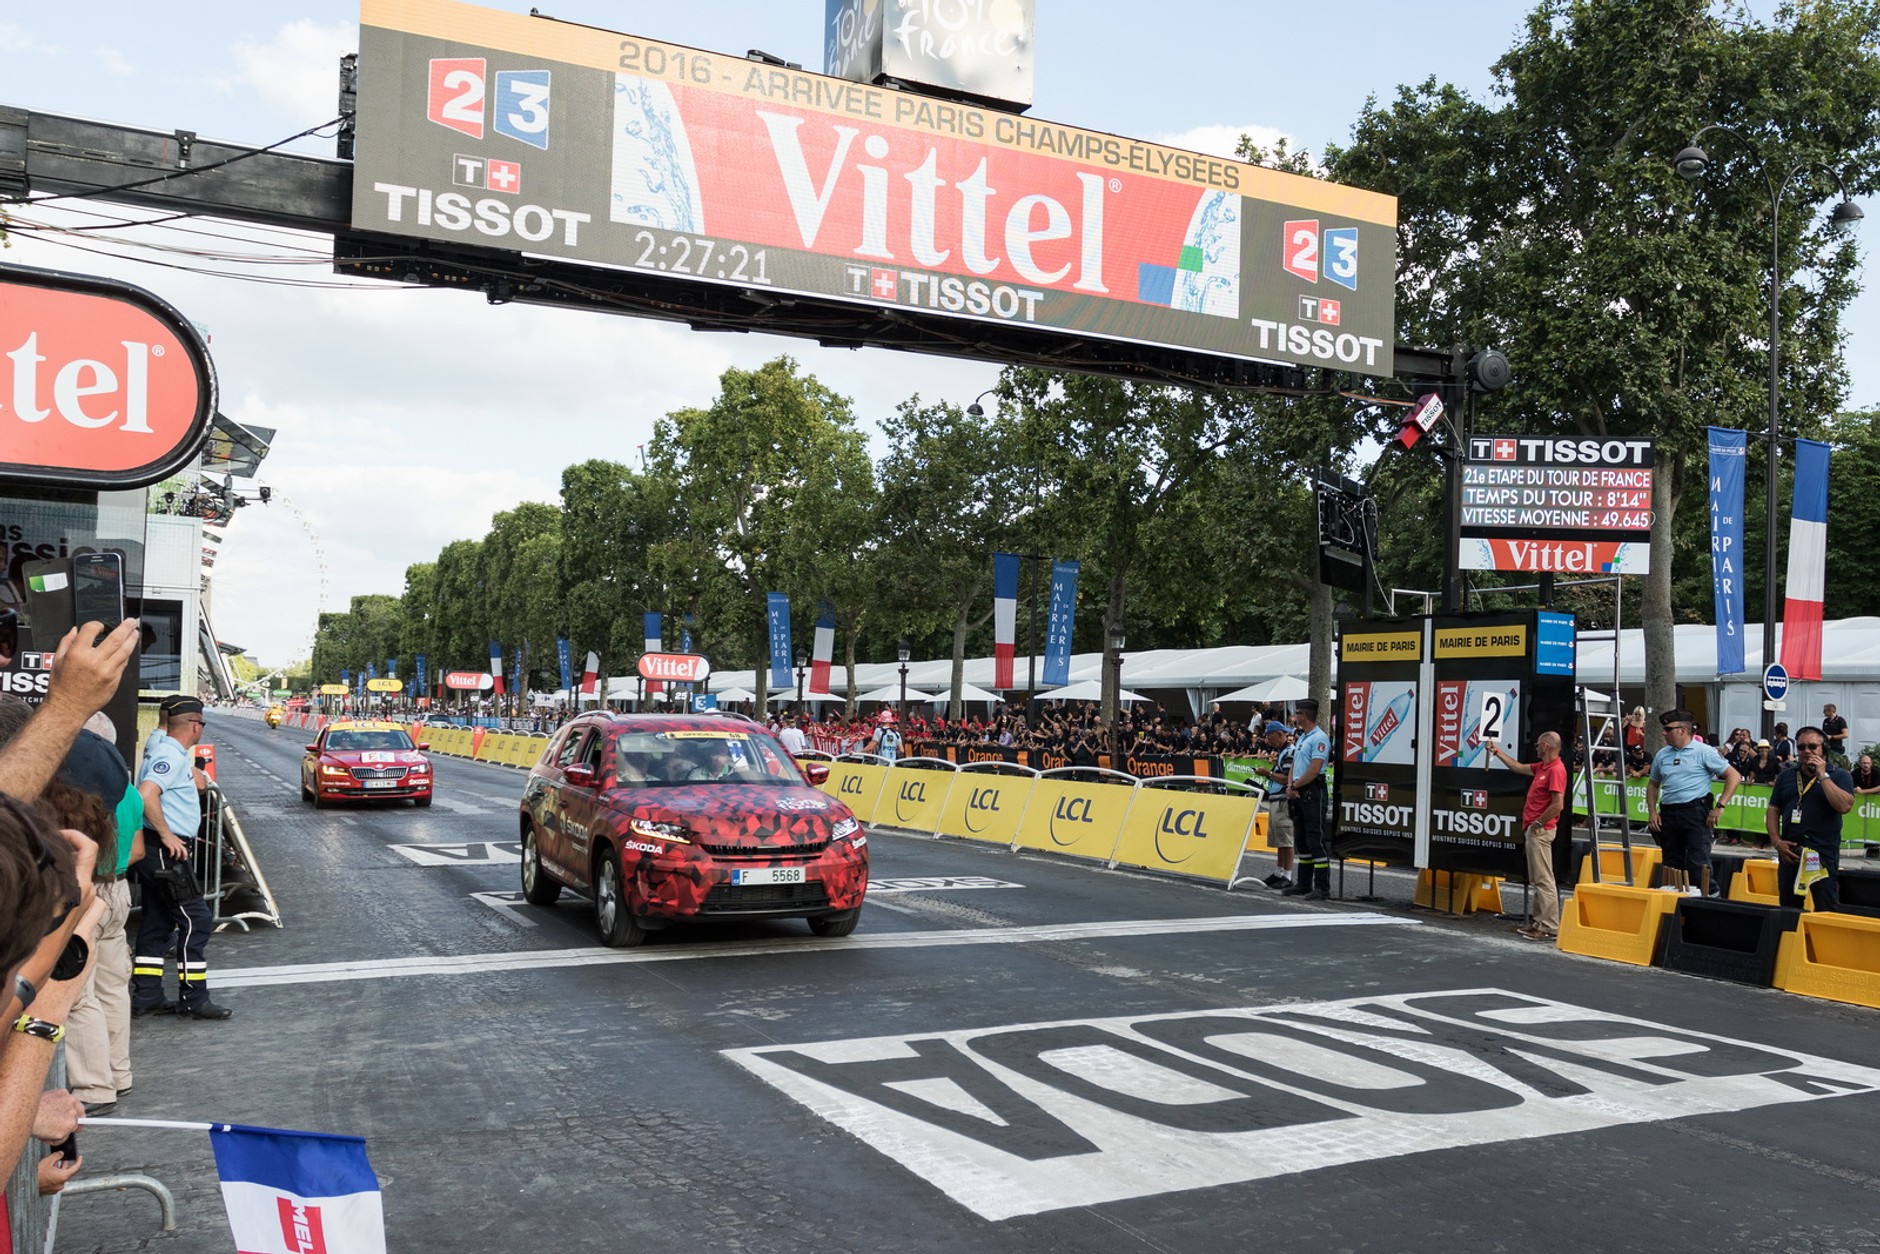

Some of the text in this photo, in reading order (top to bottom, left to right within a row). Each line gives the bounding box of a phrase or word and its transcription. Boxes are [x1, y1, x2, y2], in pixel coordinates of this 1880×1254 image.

[442, 69, 550, 134] 2 3
[619, 40, 711, 84] 2016
[895, 96, 985, 138] PARIS
[994, 117, 1240, 190] CHAMPS-ÉLYSÉES
[374, 181, 592, 247] TISSOT
[755, 109, 1110, 294] Vittel
[634, 230, 772, 285] 2:27:21
[1291, 229, 1358, 278] 2 3
[900, 270, 1044, 323] TISSOT
[1251, 318, 1383, 367] TISSOT
[0, 331, 154, 434] tel
[1421, 401, 1442, 427] TISSOT
[1519, 439, 1651, 464] TISSOT
[1464, 468, 1651, 488] 21e ETAPE DU TOUR DE FRANCE
[1467, 488, 1519, 505] TEMPS
[1523, 490, 1546, 505] DU
[1550, 490, 1593, 507] TOUR
[1463, 507, 1516, 525] VITESSE
[1519, 509, 1590, 527] MOYENNE
[1601, 511, 1649, 528] 49.645
[1722, 516, 1733, 525] DE
[1506, 540, 1595, 572] Vittel
[1722, 536, 1736, 636] PARIS
[1050, 582, 1064, 644] MAIRIE
[1057, 614, 1068, 667] PARIS
[771, 610, 780, 657] MAIRIE
[780, 633, 789, 674] PARIS
[1346, 640, 1416, 653] MAIRIE DE PARIS
[1439, 634, 1520, 649] MAIRIE DE PARIS
[641, 656, 695, 677] Vittel
[0, 672, 50, 694] ISS
[449, 675, 477, 687] Vittel
[674, 691, 688, 700] 25
[1346, 685, 1365, 759] Vittel
[1371, 712, 1397, 744] Vittel
[1438, 684, 1459, 763] Vittel
[1482, 696, 1502, 738] 2
[968, 748, 1004, 769] Orange
[1126, 756, 1175, 778] Orange
[841, 775, 863, 794] LCL
[900, 781, 926, 802] LCL
[970, 788, 1000, 811] LCL
[1056, 796, 1094, 823] LCL
[1161, 807, 1208, 838] LCL
[1341, 801, 1413, 827] TISSOT
[1433, 809, 1517, 837] TISSOT
[567, 816, 588, 839] ŠKODA
[1363, 827, 1382, 836] SUISSES
[625, 839, 663, 855] ŠKODA
[1432, 834, 1456, 843] MONTRES
[1457, 836, 1481, 846] SUISSES
[1481, 839, 1502, 849] DEPUIS
[742, 871, 748, 883] F
[772, 869, 800, 882] 5568
